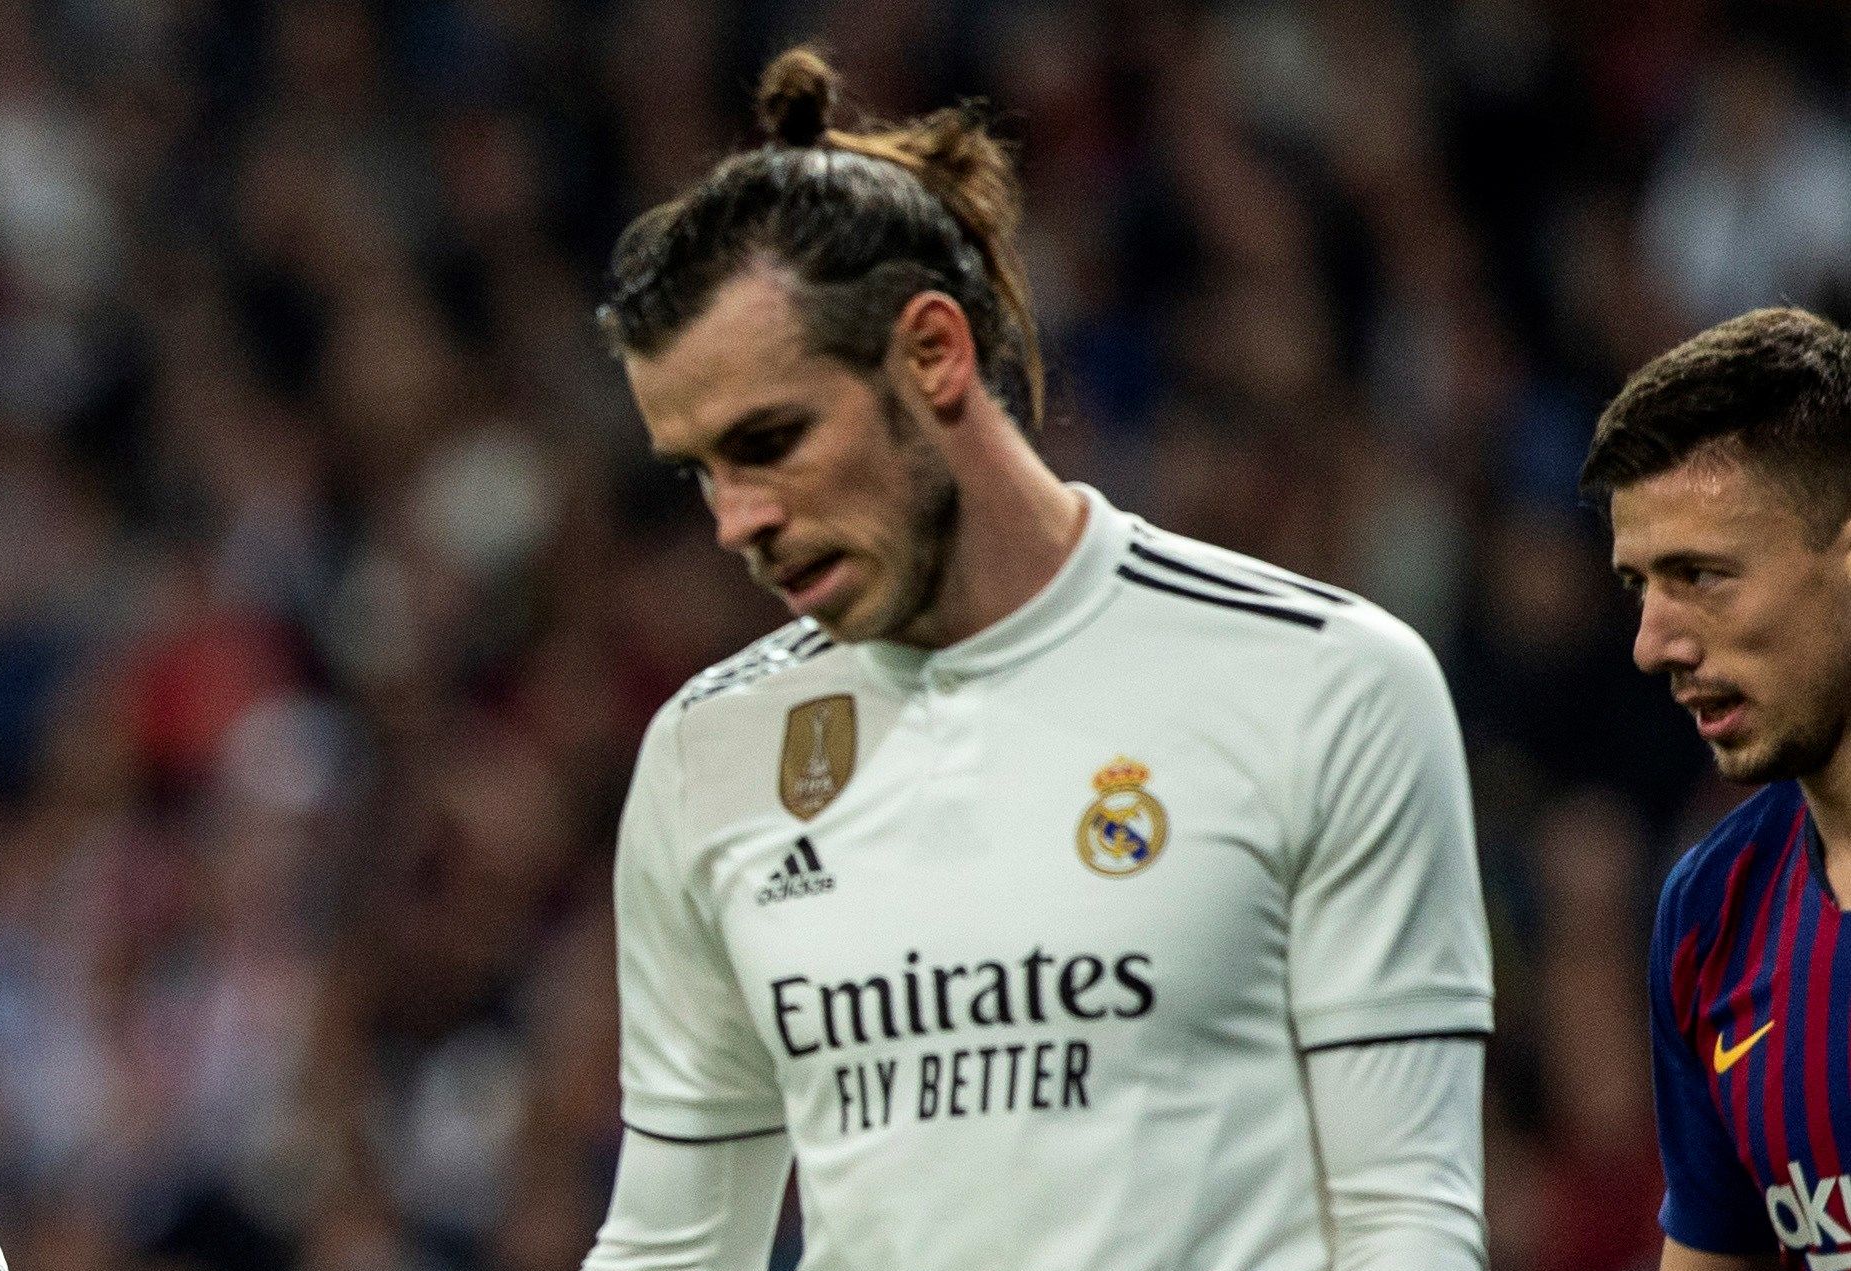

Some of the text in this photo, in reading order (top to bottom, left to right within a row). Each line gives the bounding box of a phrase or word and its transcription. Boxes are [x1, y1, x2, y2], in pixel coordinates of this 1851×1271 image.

[770, 944, 1157, 1060] Emirates
[834, 1039, 1092, 1134] FLY BETTER
